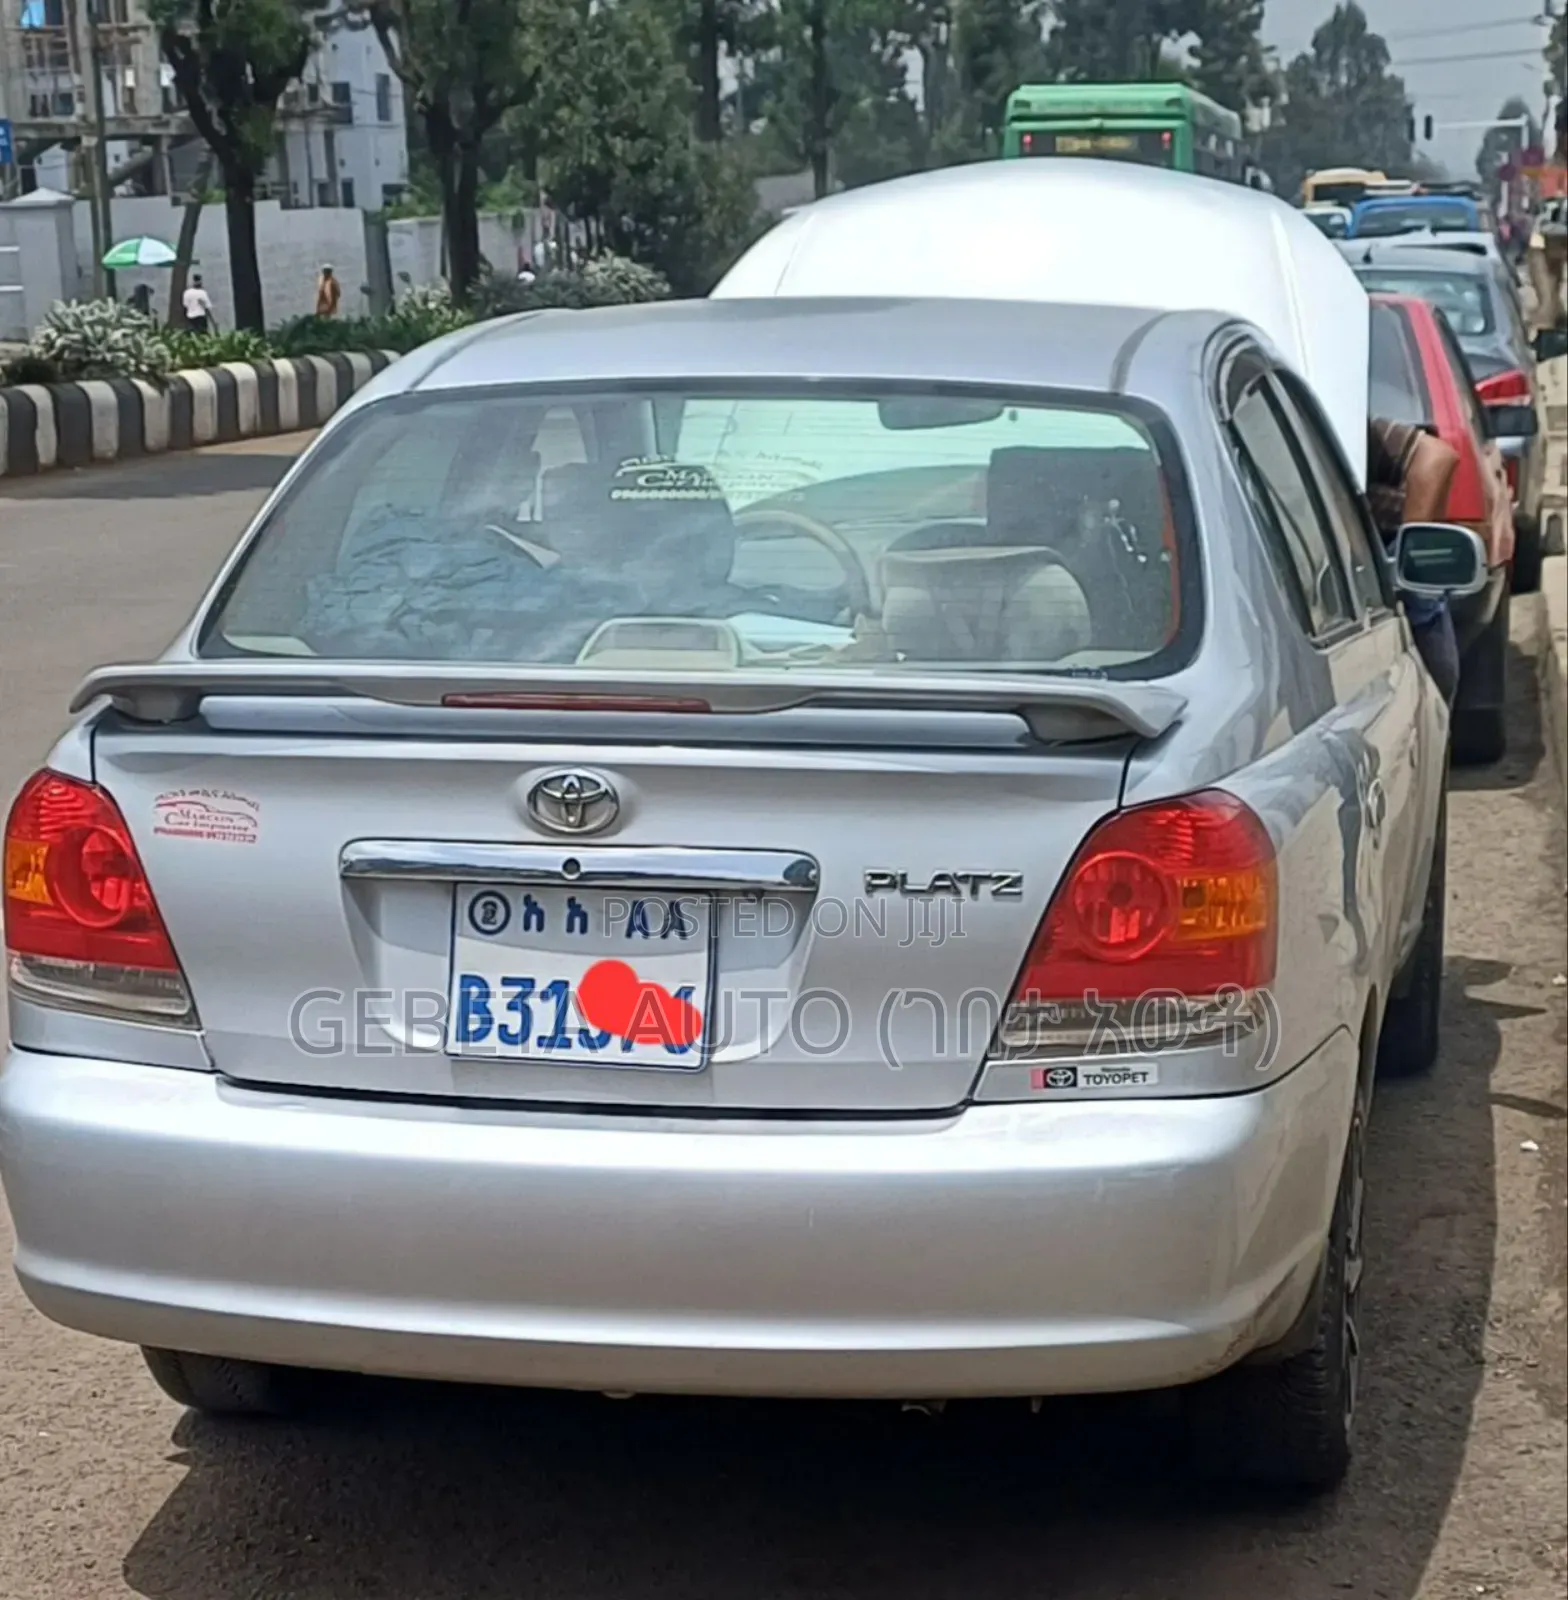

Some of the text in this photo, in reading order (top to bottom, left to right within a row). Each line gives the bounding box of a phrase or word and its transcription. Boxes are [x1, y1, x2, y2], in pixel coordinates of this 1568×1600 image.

[863, 869, 1024, 897] PLATZ
[456, 974, 696, 1055] B31
[1083, 1071, 1149, 1086] TOYOPET
